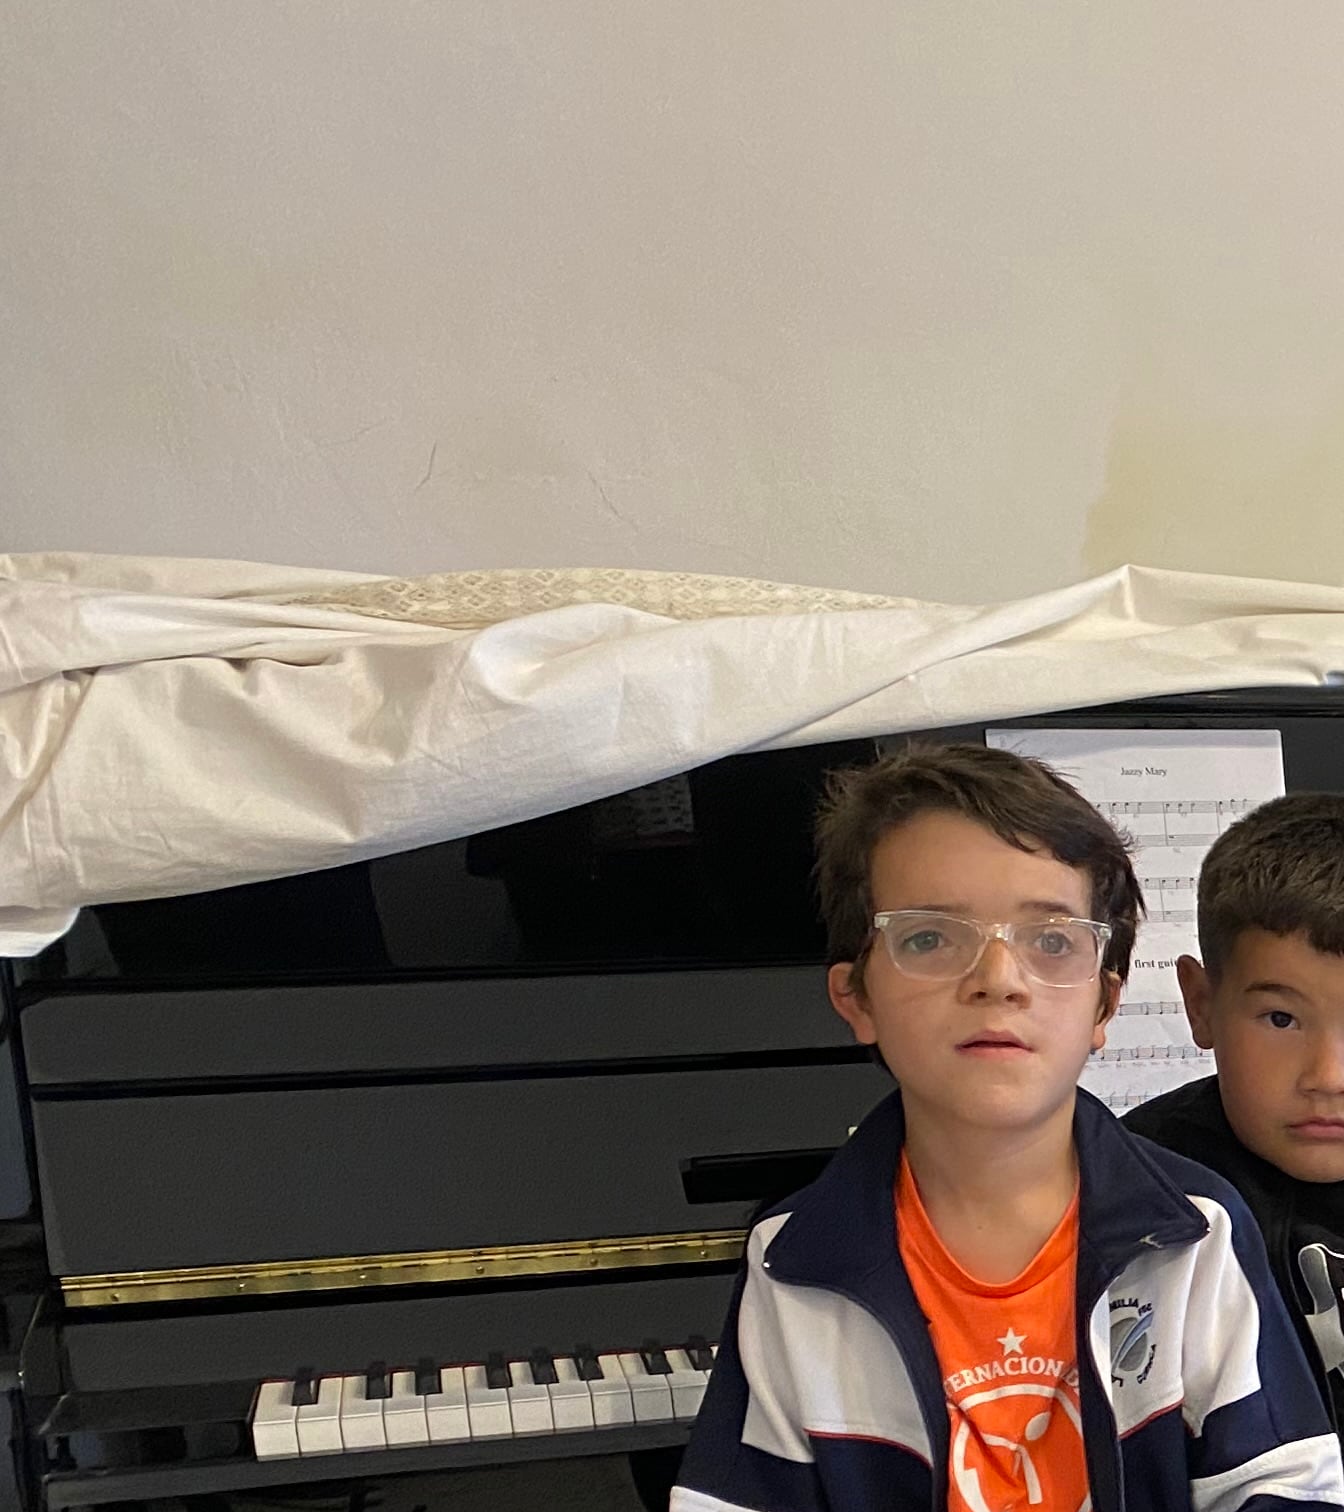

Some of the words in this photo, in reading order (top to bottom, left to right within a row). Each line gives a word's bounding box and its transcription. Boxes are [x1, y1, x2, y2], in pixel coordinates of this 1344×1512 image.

[1120, 767, 1142, 777] Jazzy
[1144, 766, 1168, 777] Mary
[1134, 960, 1155, 968] first
